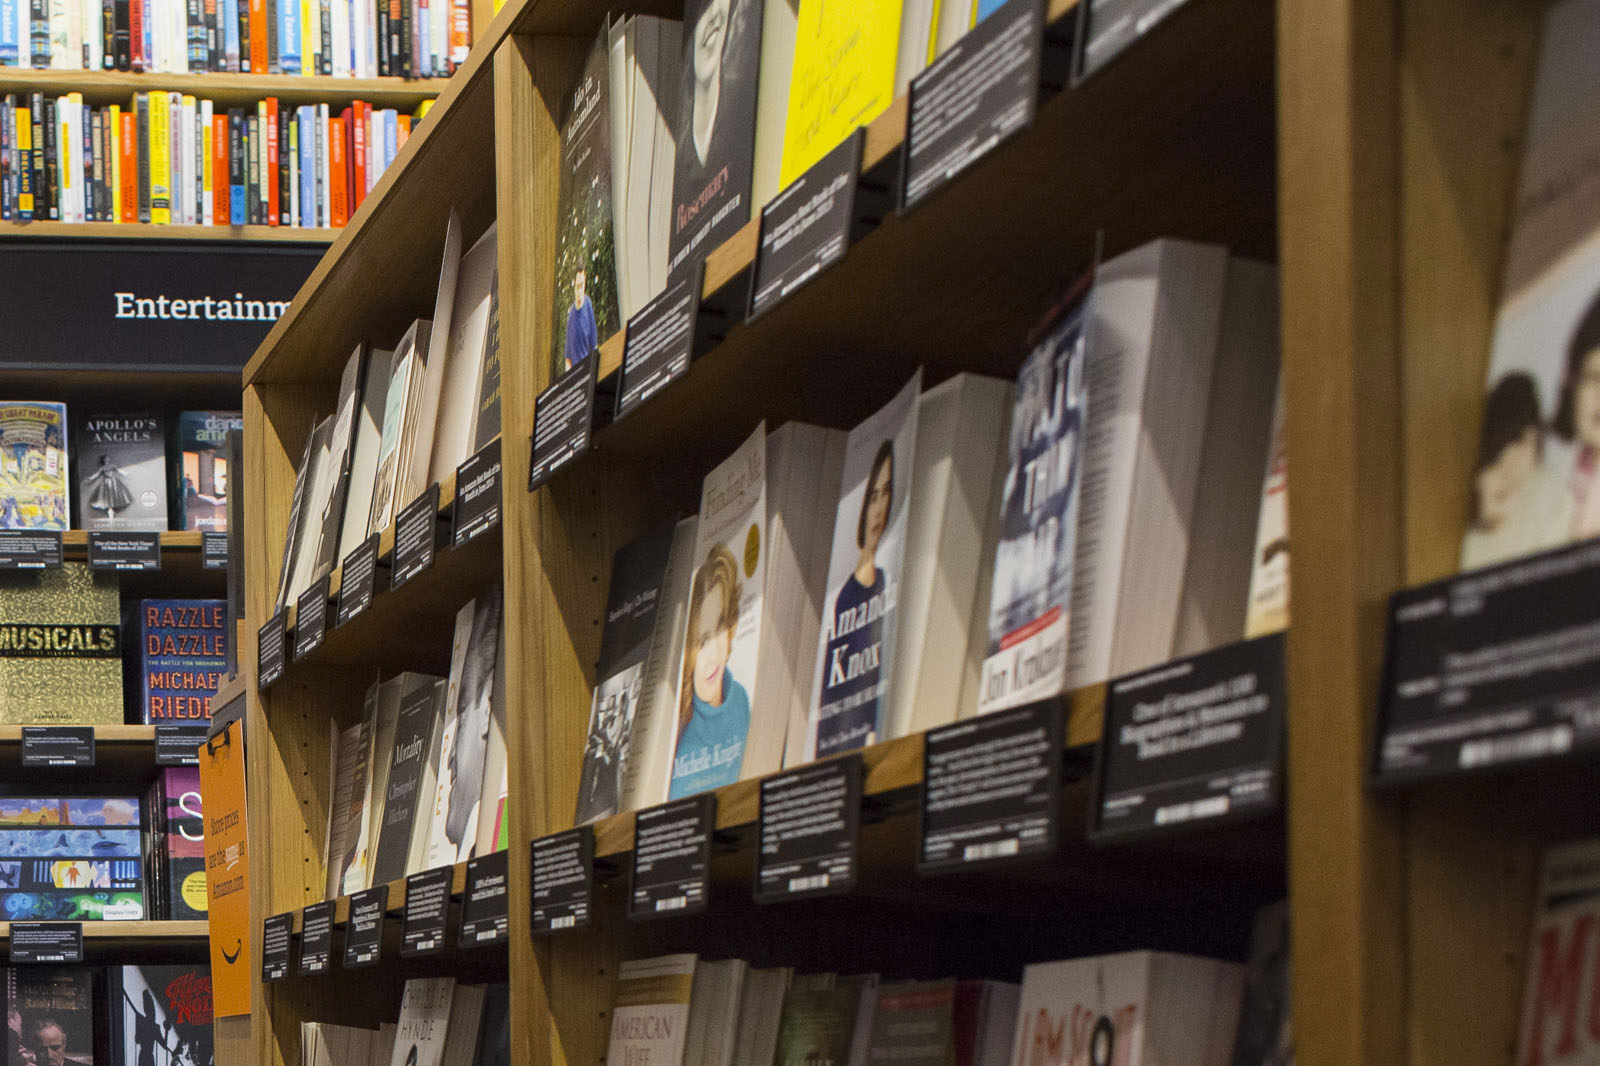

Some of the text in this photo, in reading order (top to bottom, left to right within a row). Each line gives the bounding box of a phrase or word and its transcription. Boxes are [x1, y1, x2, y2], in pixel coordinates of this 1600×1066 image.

[676, 165, 729, 235] Rosemary
[86, 419, 157, 431] APOLLO'S
[93, 431, 151, 443] ANGELS
[147, 607, 224, 629] RAZZLE
[148, 634, 225, 656] DAZZLE
[826, 640, 880, 688] Knox
[393, 734, 425, 766] Mortality
[673, 747, 711, 779] Michelle
[210, 809, 240, 837] Store prices
[213, 875, 245, 899] Amazon.com
[400, 1020, 435, 1041] HYNDE
[612, 1015, 671, 1042] AMERICAN
